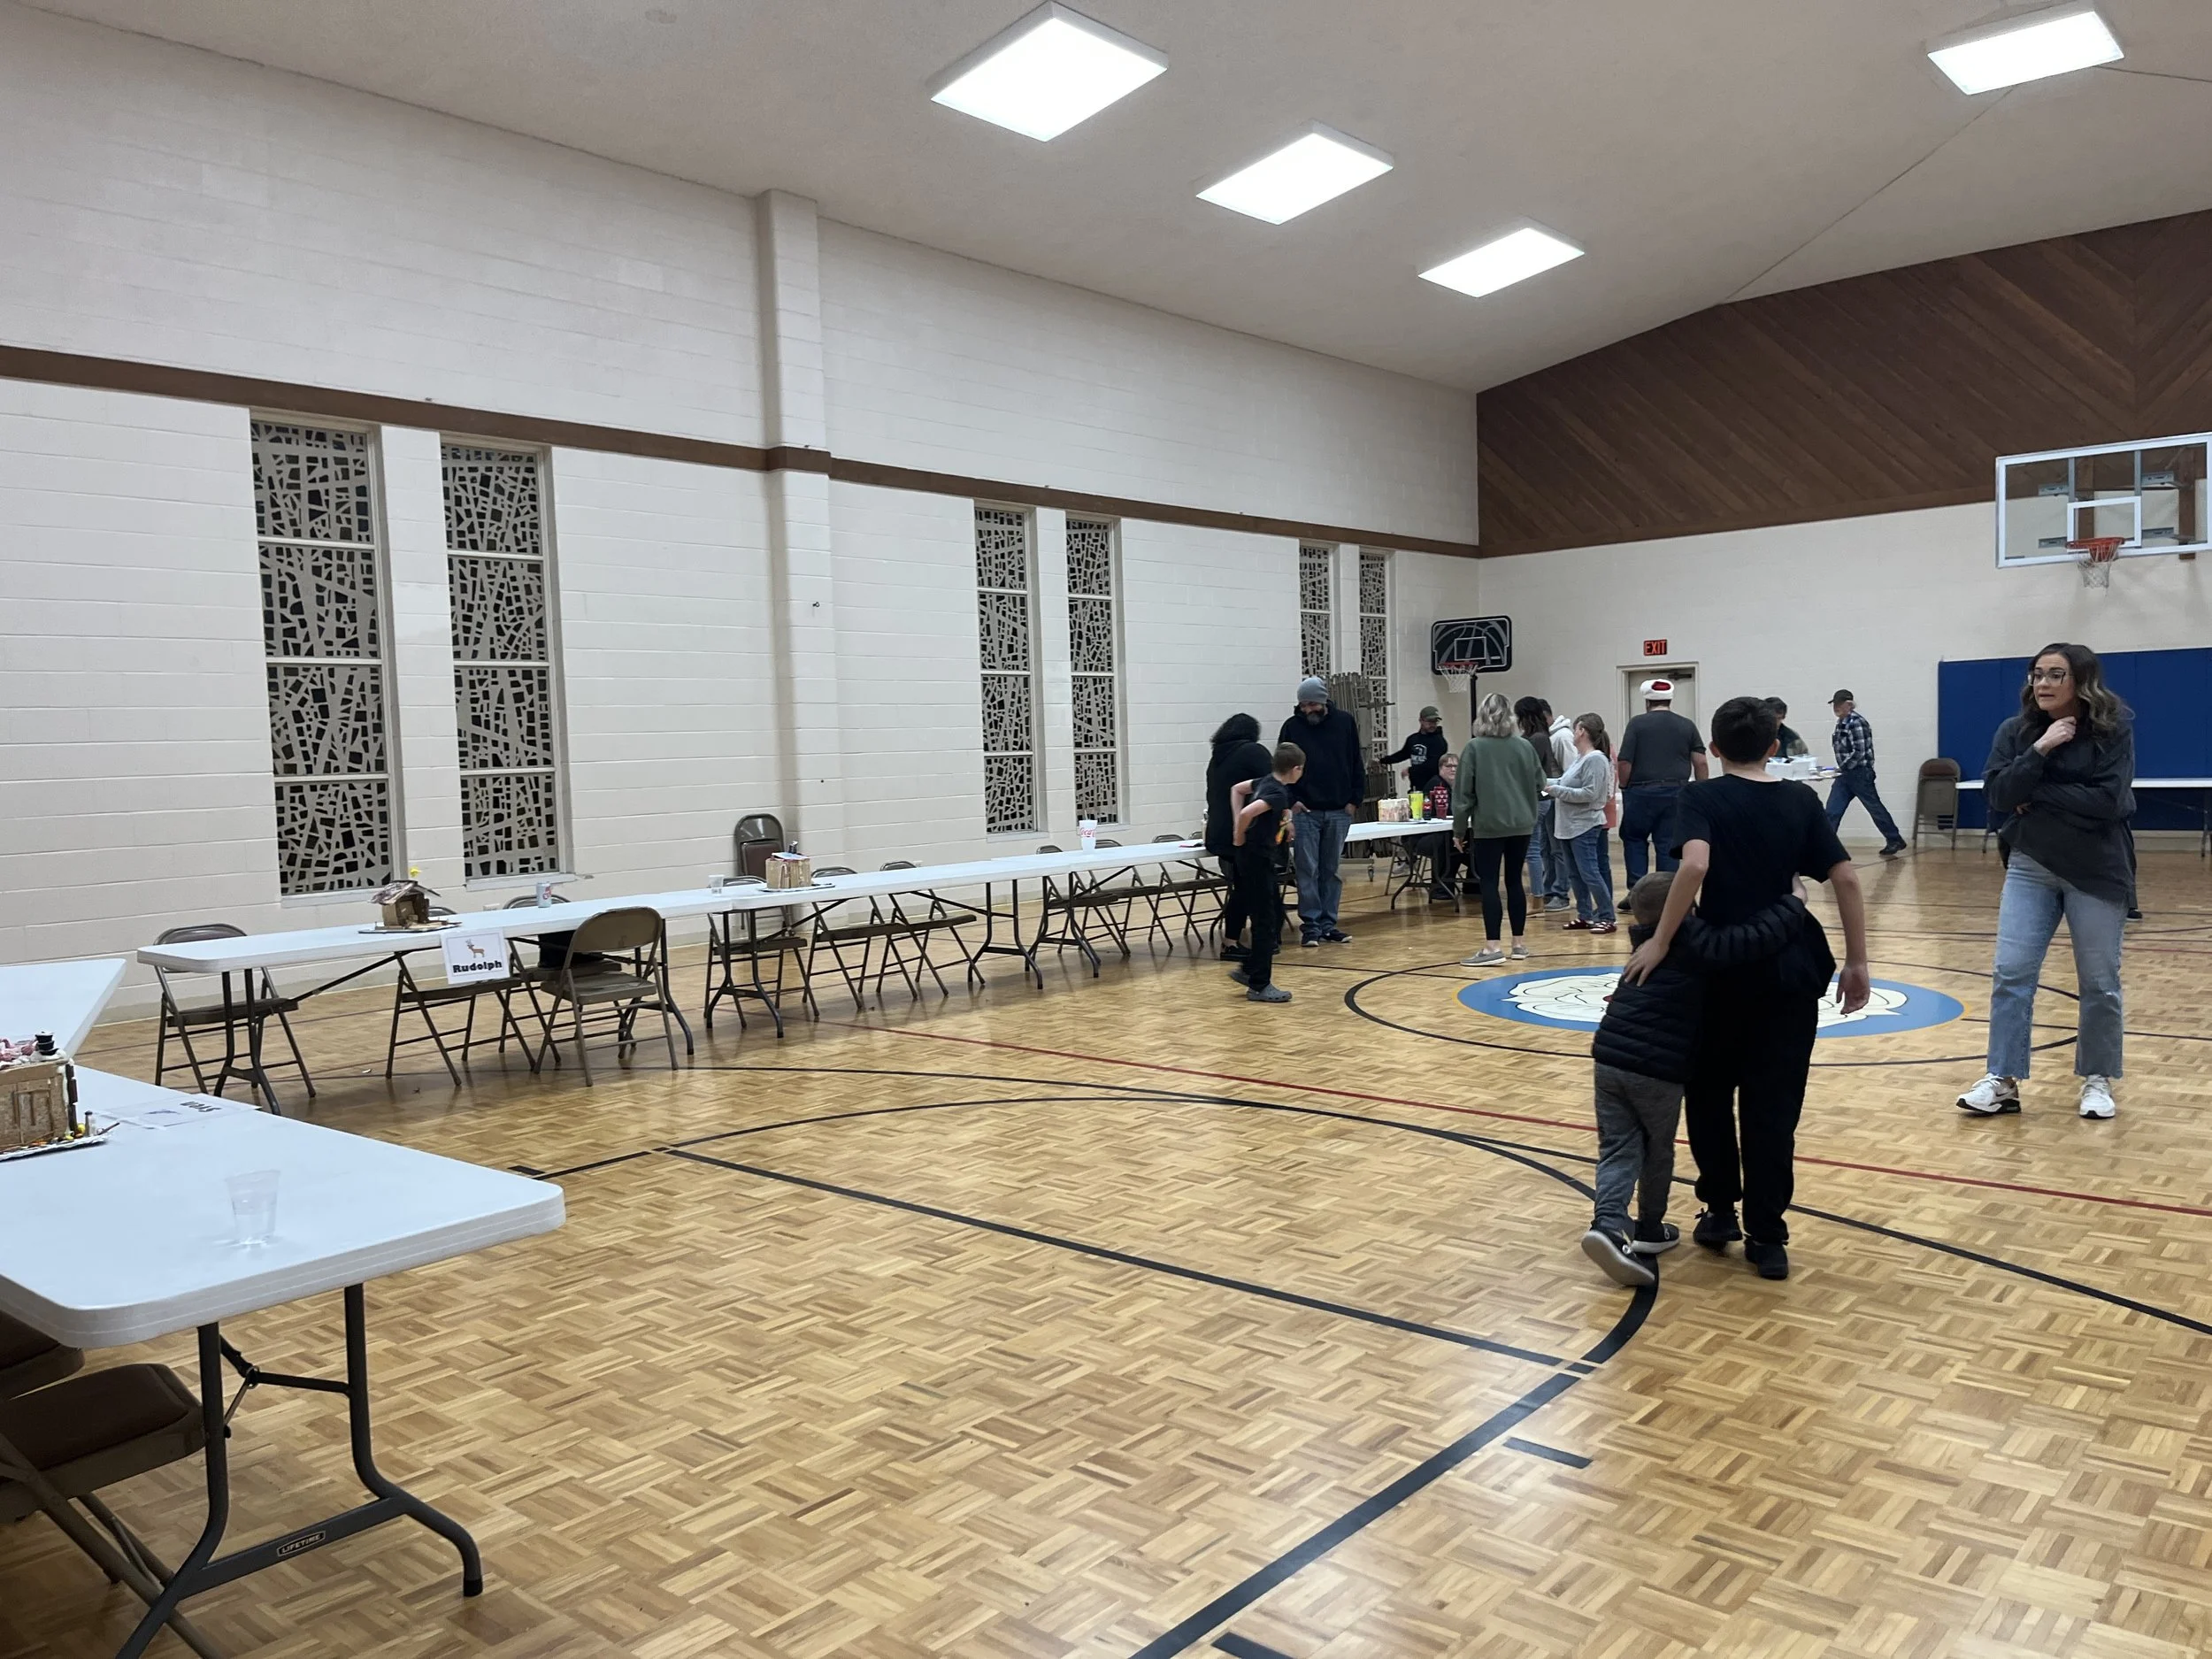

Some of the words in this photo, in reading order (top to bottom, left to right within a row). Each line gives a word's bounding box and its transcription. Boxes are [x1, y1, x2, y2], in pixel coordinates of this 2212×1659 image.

[1645, 641, 1666, 655] EXIT
[452, 960, 503, 973] Rudolph
[281, 1533, 322, 1554] LIFETIME
